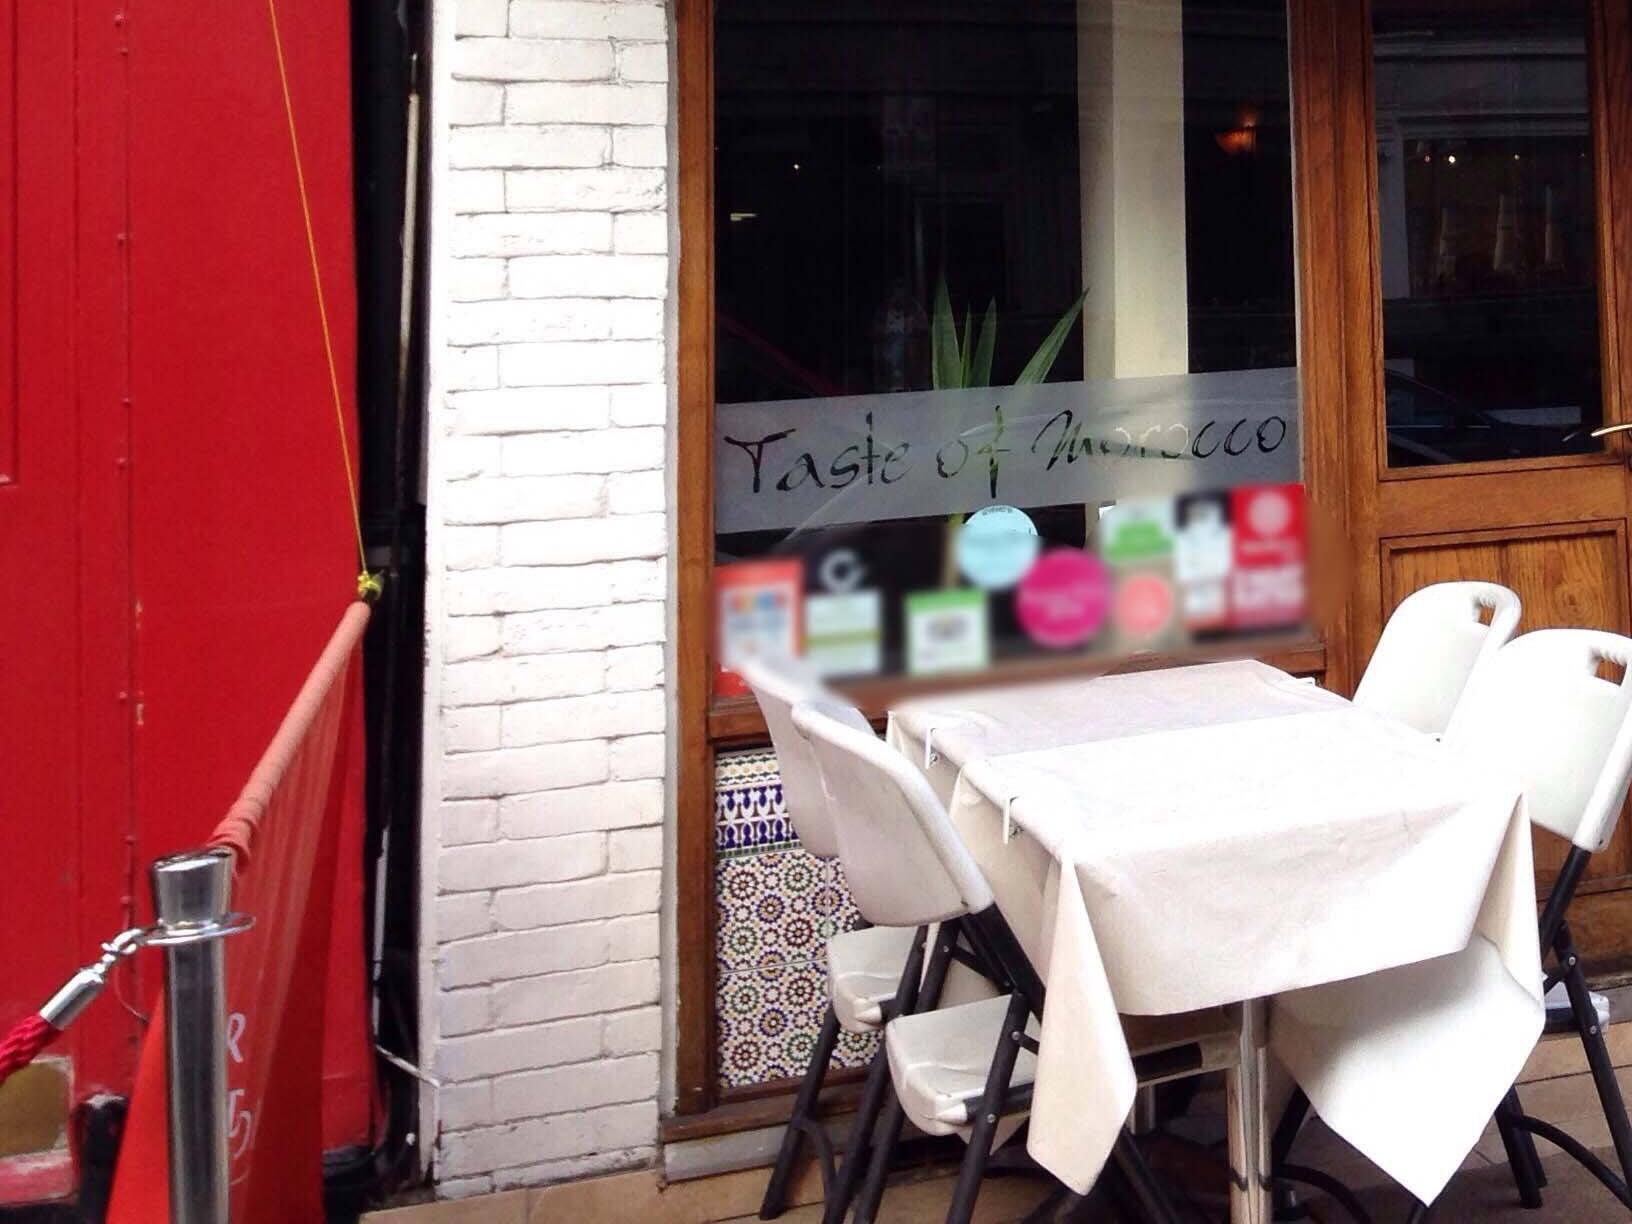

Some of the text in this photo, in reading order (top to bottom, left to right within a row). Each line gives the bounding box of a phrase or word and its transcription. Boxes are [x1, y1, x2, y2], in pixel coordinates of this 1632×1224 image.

[723, 404, 1287, 499] Taste of Morocco
